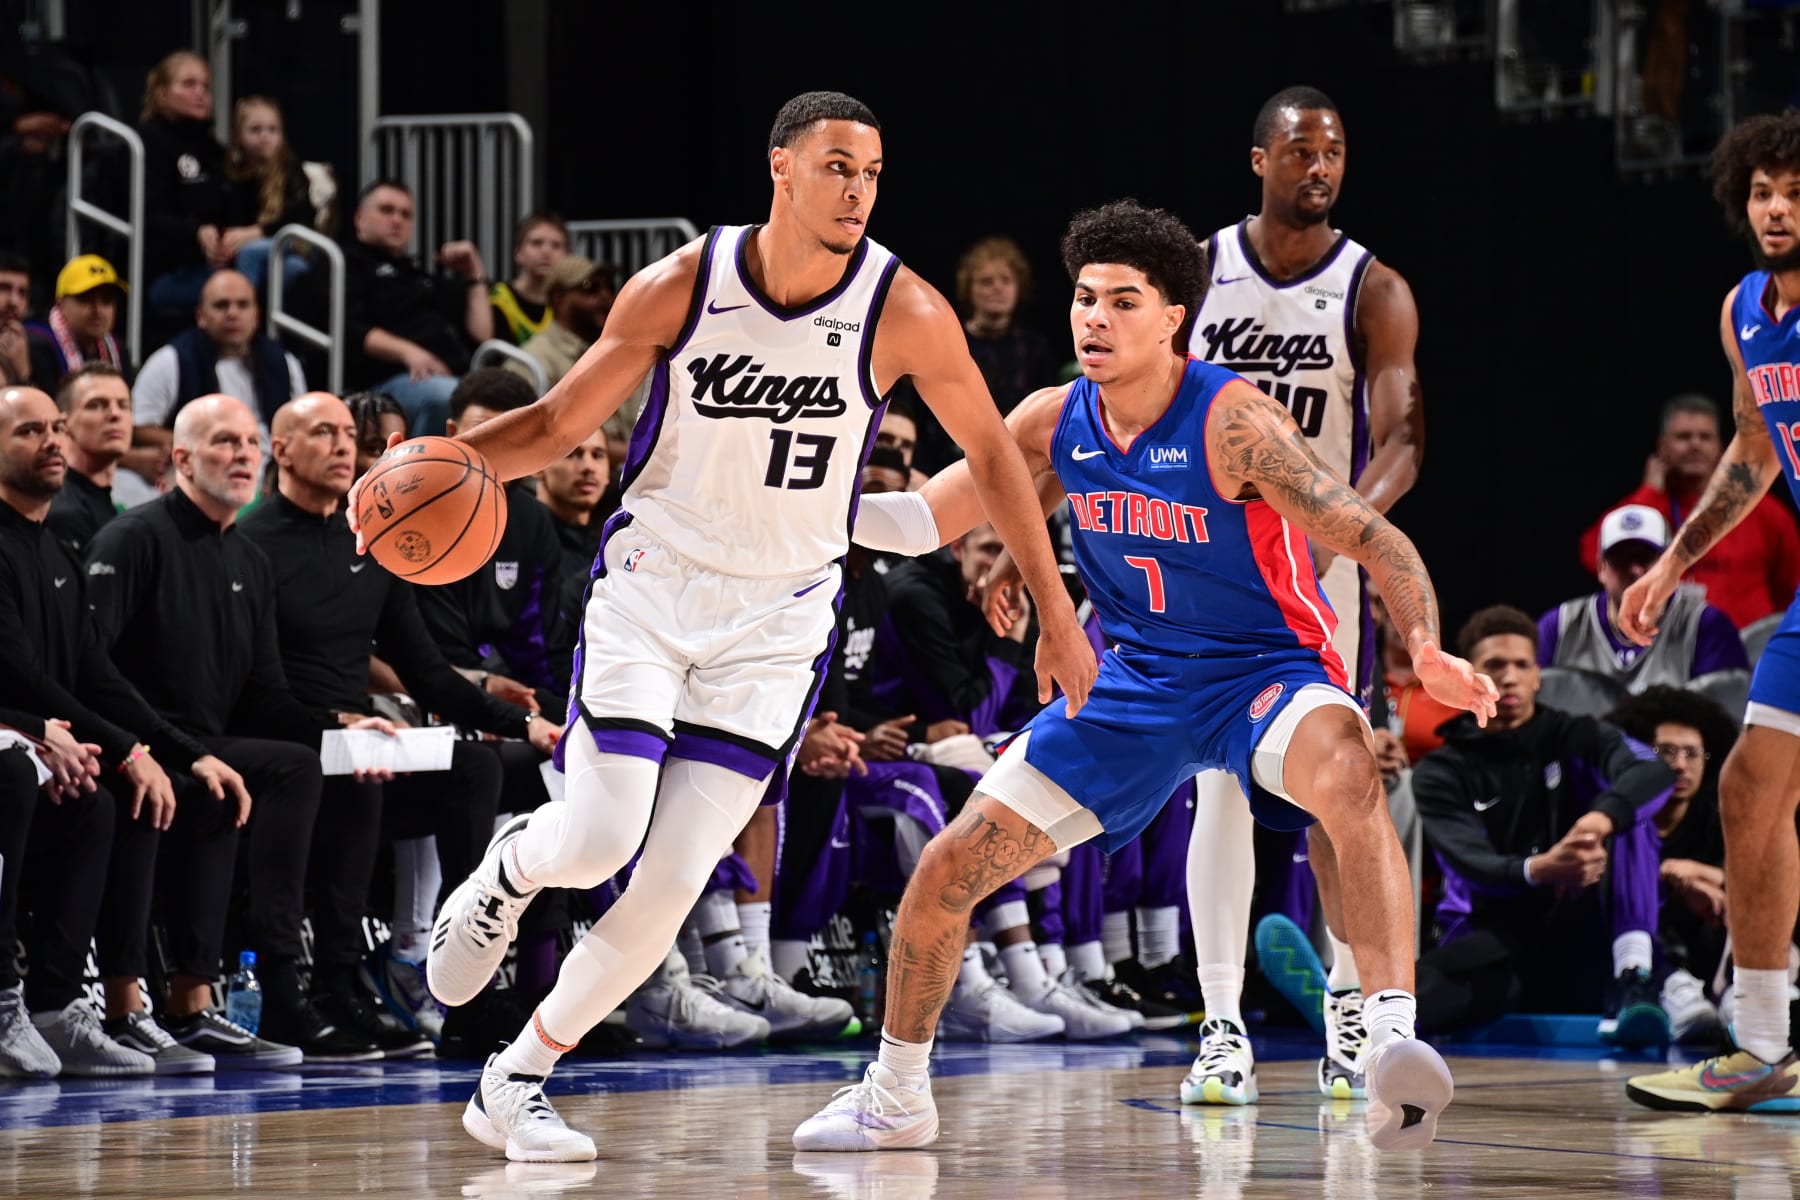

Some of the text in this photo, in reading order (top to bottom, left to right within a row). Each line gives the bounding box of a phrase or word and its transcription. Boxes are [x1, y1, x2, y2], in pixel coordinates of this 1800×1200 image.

[813, 316, 861, 332] dialpad
[1201, 317, 1334, 377] Kings
[686, 353, 847, 424] Kings
[763, 428, 838, 490] 13
[1150, 447, 1188, 463] UWM
[1066, 490, 1210, 543] DETROIT
[1123, 555, 1166, 613] 7
